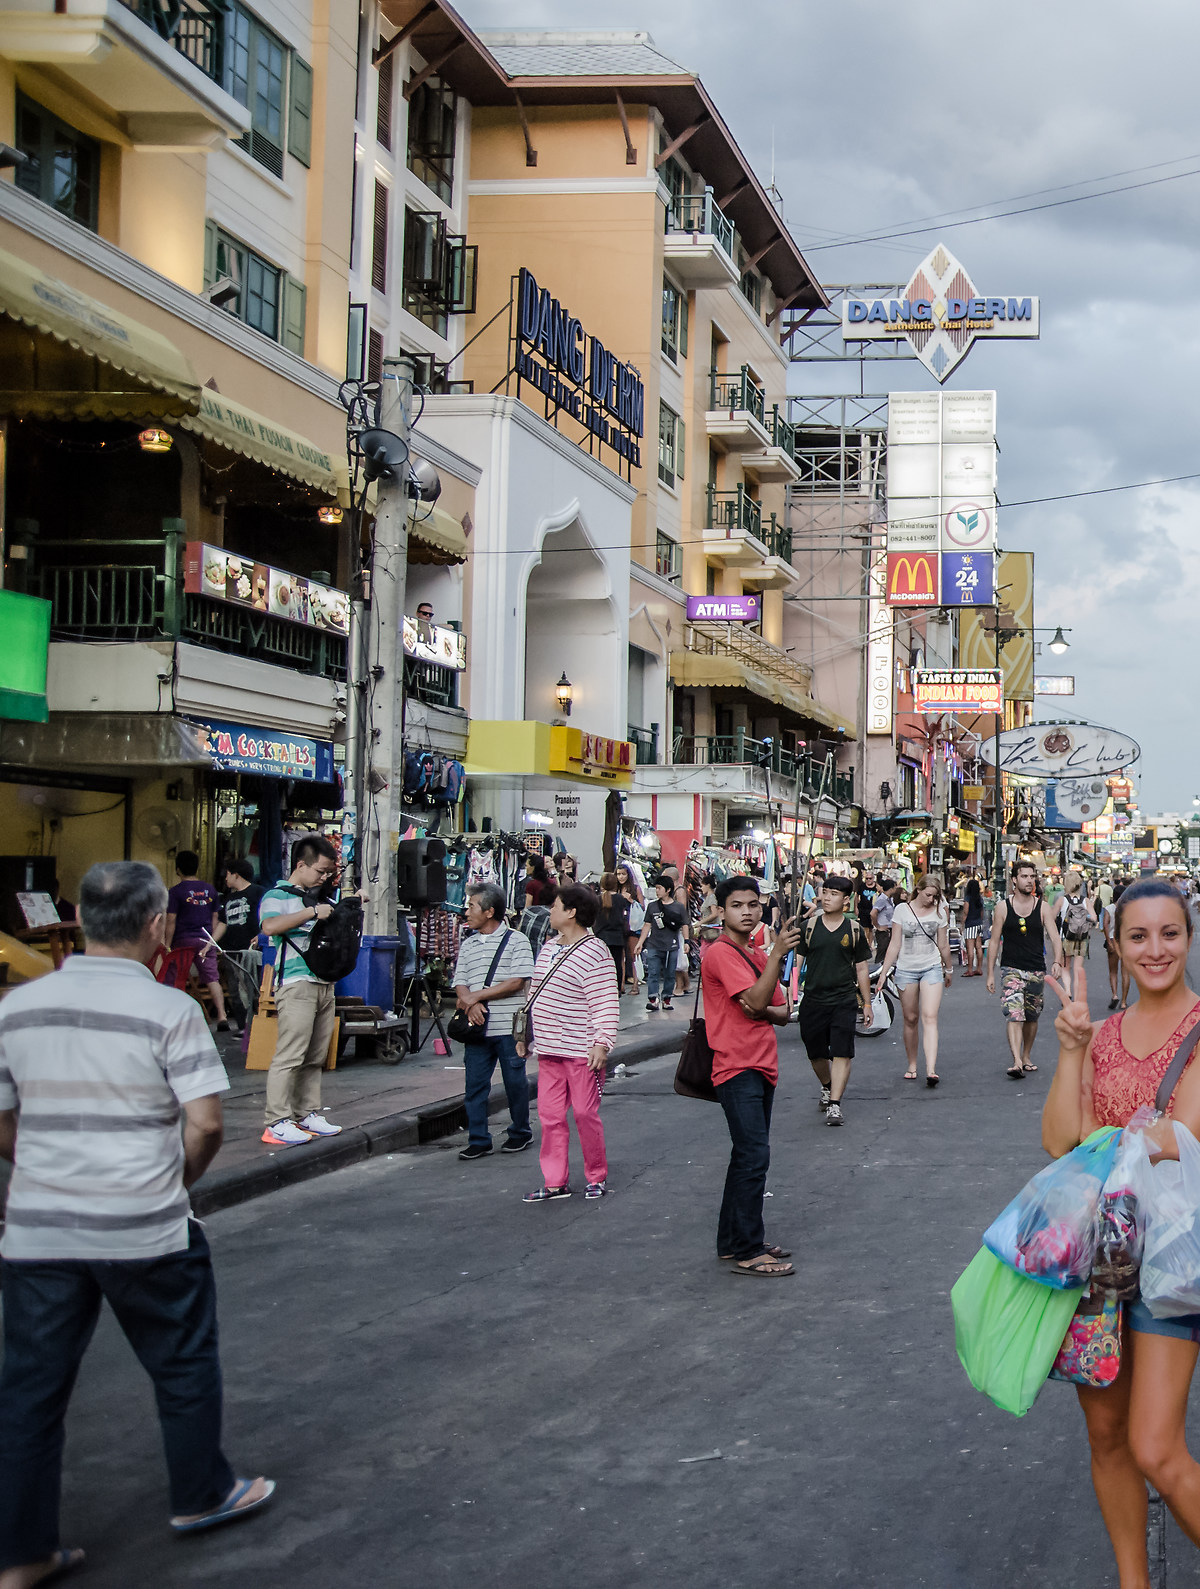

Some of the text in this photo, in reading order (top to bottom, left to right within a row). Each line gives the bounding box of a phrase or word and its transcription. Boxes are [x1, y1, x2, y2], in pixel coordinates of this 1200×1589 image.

[848, 298, 1032, 322] DANG DERM
[884, 320, 994, 332] Authentic Thai Hotel
[518, 267, 644, 438] DANG DERM
[517, 352, 582, 420] AUTHENTIC
[258, 423, 294, 454] FUSION
[296, 441, 332, 472] CUISINE
[955, 570, 979, 587] 24
[696, 604, 726, 616] ATM
[920, 673, 997, 684] TASTE OF INDIA
[918, 685, 999, 701] INDIAN FOOD
[237, 733, 311, 766] COCKTAILS
[1000, 737, 1133, 766] The Club
[555, 794, 581, 804] Pranakorn
[556, 807, 579, 818] Bangkok
[1111, 833, 1133, 841] BAG
